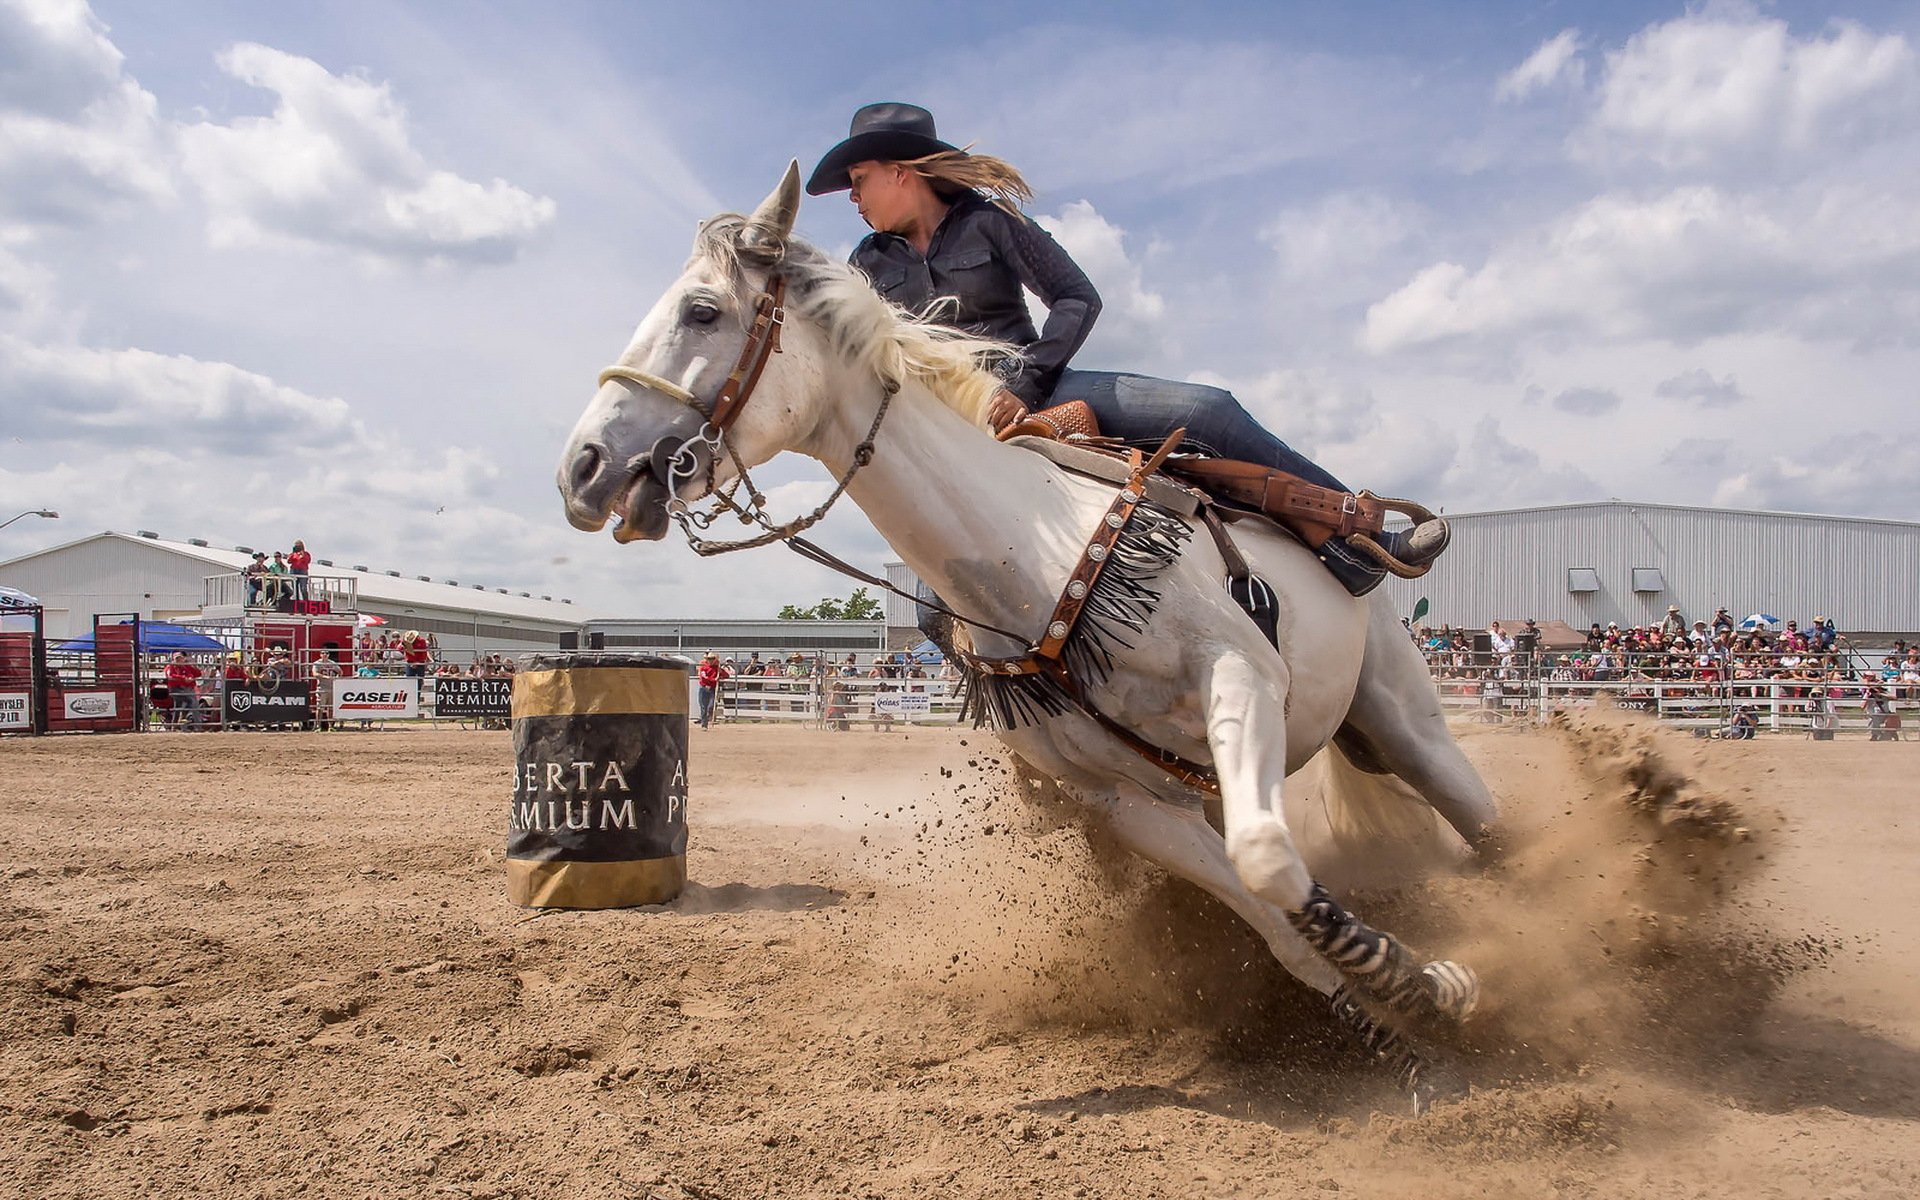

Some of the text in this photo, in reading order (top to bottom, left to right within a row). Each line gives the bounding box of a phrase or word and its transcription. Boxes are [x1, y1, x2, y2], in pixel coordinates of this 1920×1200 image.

[439, 682, 511, 692] ALBERTA
[252, 696, 306, 705] RAM
[342, 692, 391, 702] CASE
[436, 695, 513, 705] PREMIUM
[1617, 701, 1647, 709] ONY
[509, 799, 638, 833] EMIUM
